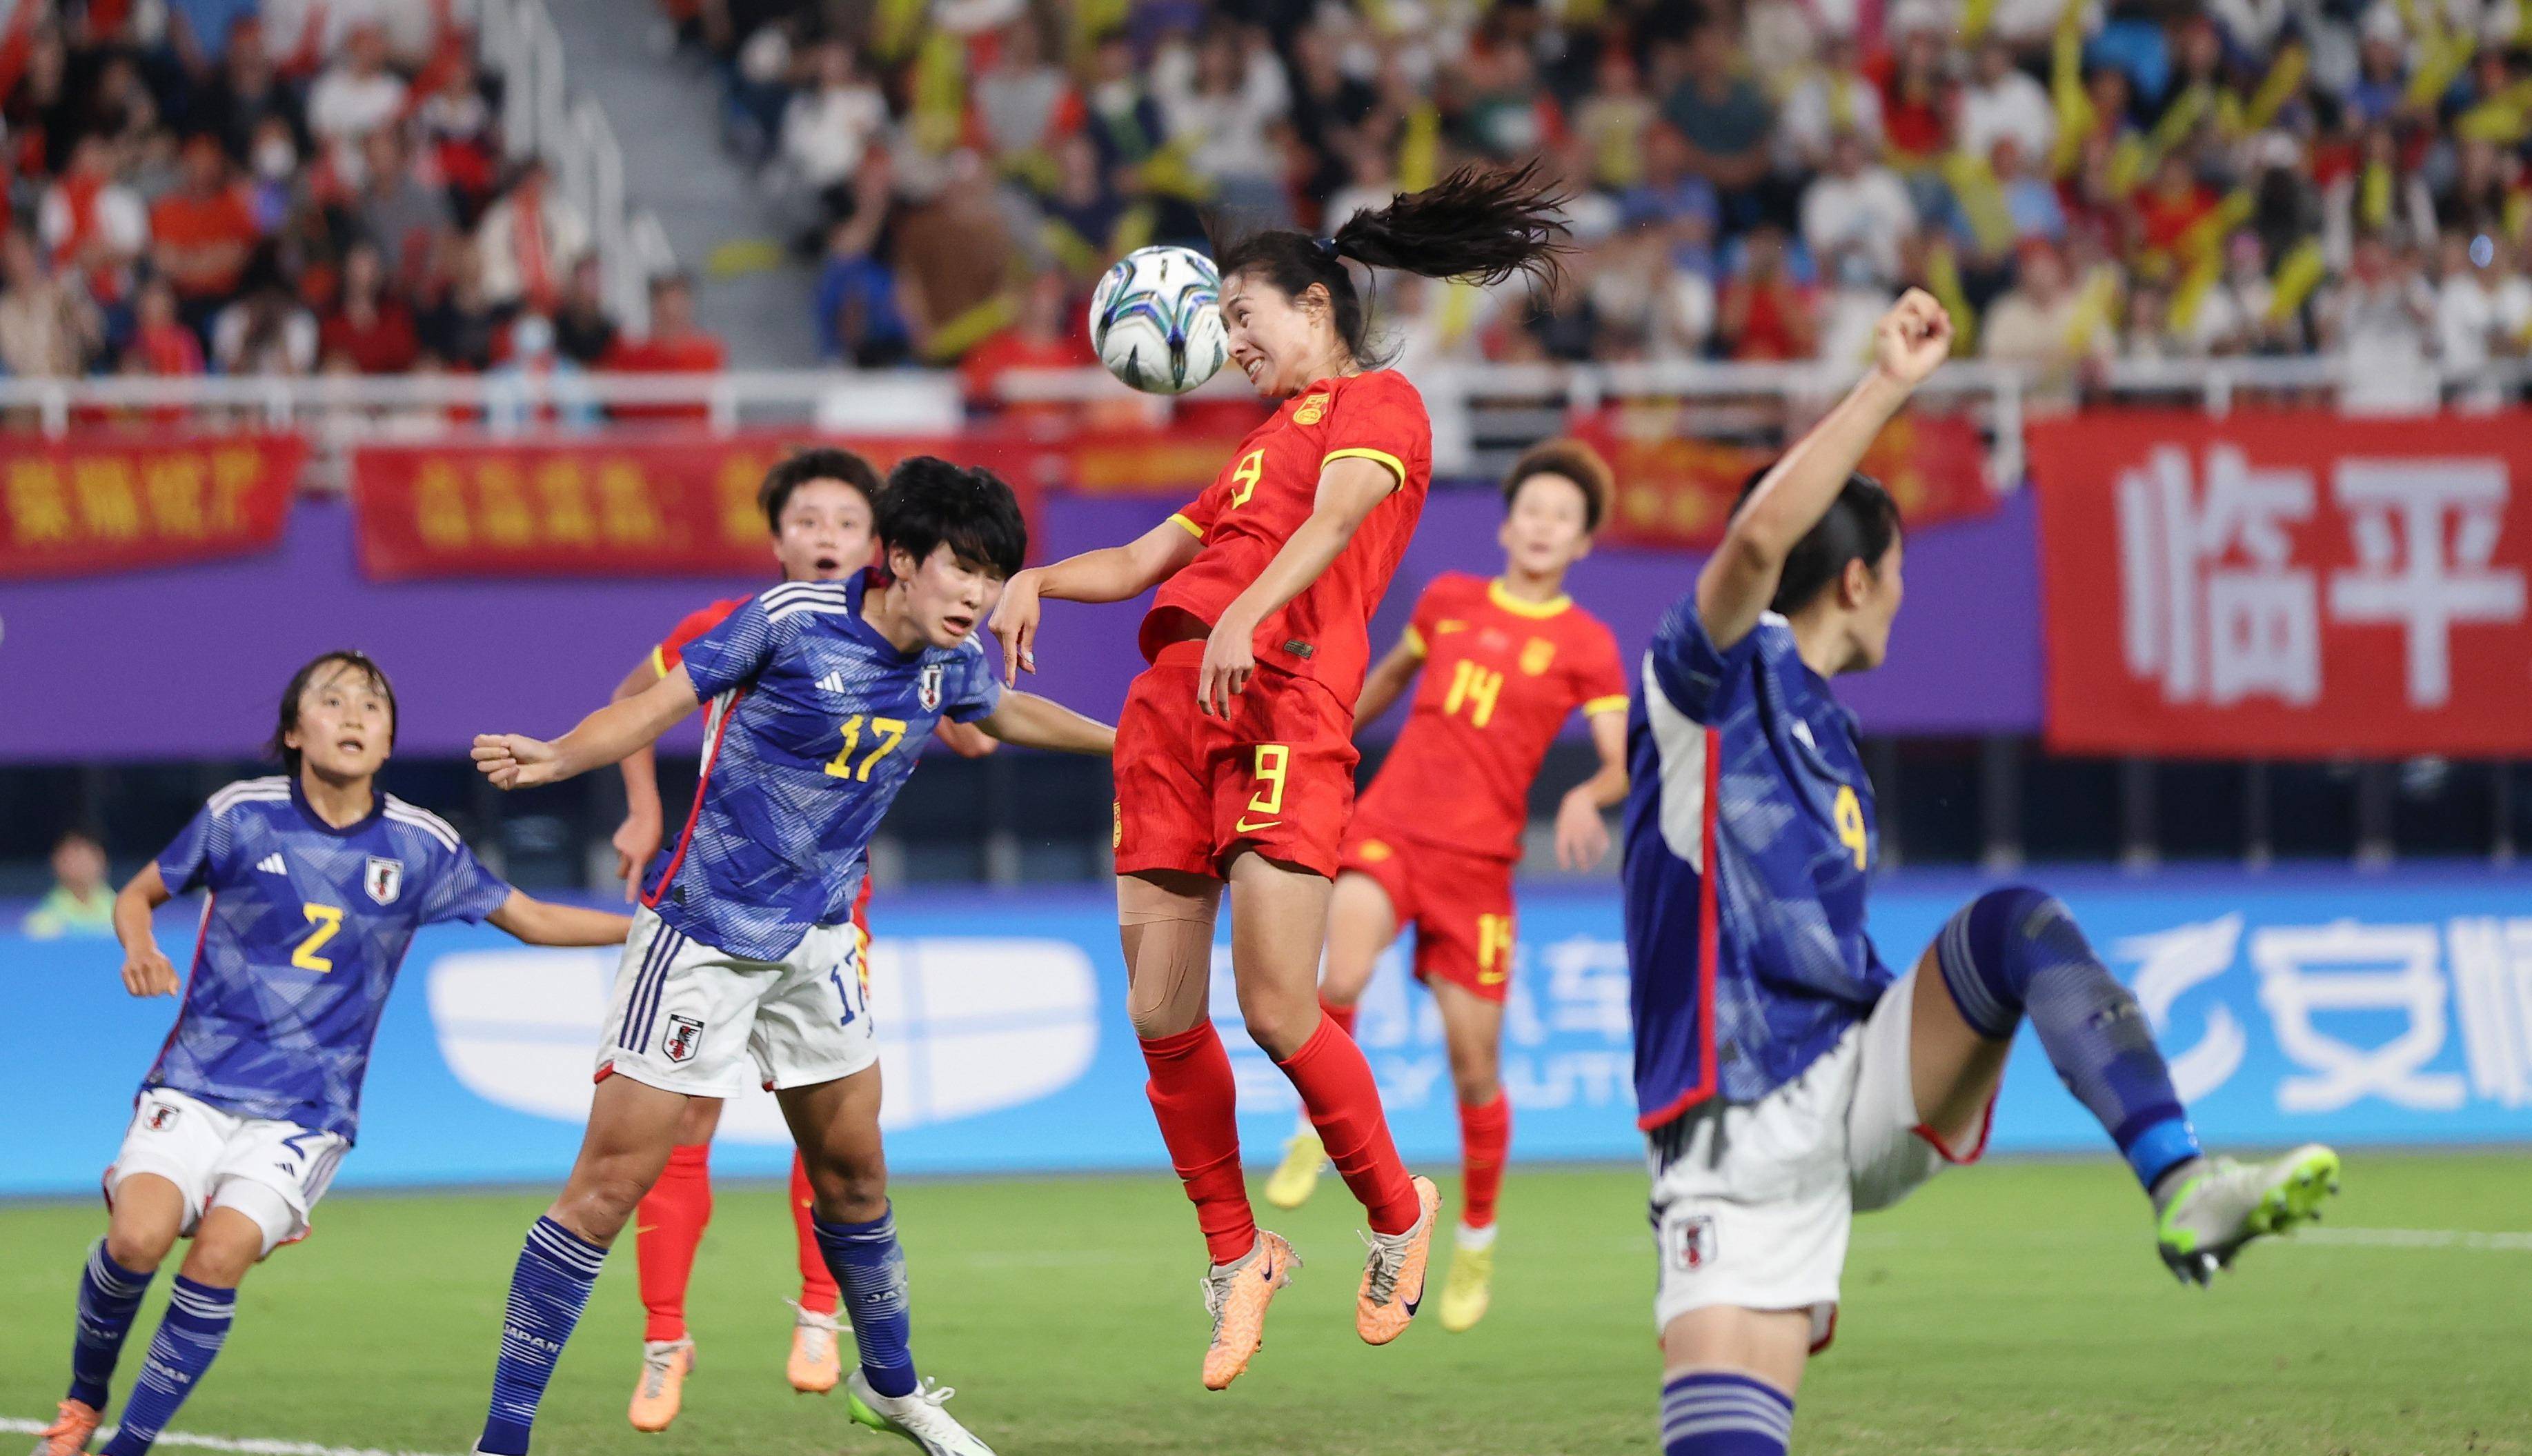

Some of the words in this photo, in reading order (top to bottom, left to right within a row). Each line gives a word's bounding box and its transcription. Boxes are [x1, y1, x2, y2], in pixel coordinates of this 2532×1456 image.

[1231, 448, 1265, 509] 9
[2115, 441, 2526, 709] 临平
[1444, 659, 1504, 728] 14
[824, 714, 908, 784] 17
[1247, 744, 1289, 815] 9
[1833, 784, 1867, 870] 9
[291, 902, 343, 974] 2
[503, 1323, 561, 1353] JAPAN
